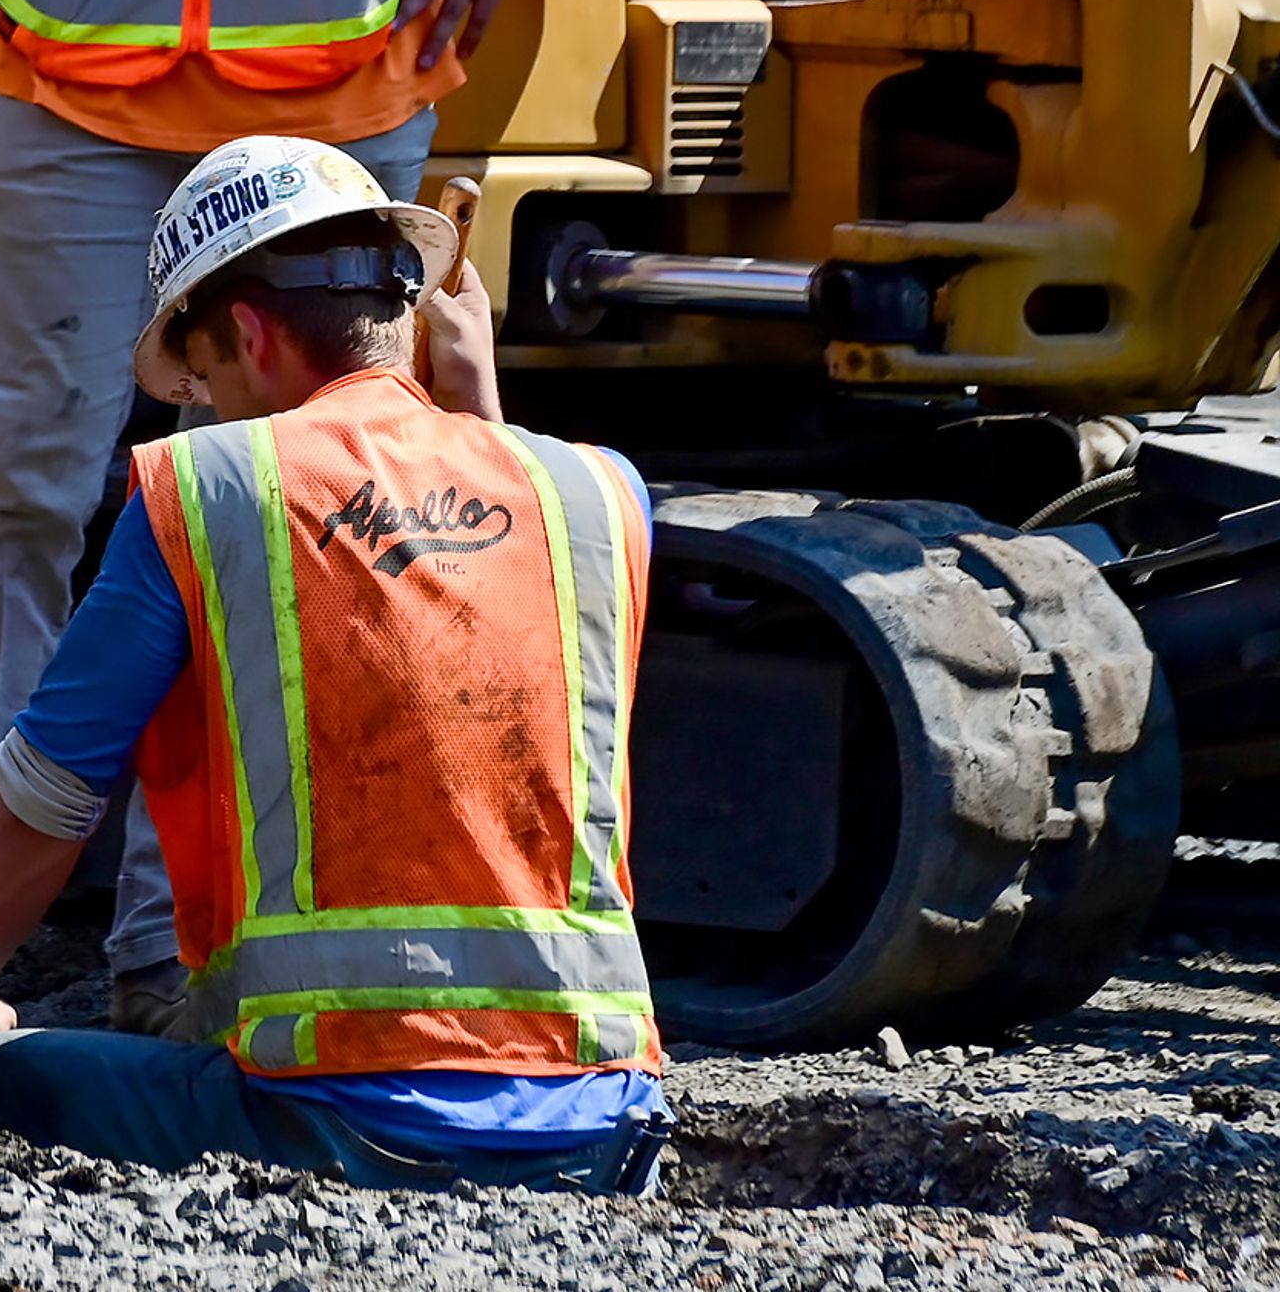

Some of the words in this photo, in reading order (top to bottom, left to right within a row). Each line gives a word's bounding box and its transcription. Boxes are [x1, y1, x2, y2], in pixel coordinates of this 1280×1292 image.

[187, 173, 269, 248] STRONG
[317, 479, 511, 554] Apollo
[435, 558, 466, 575] Inc.
